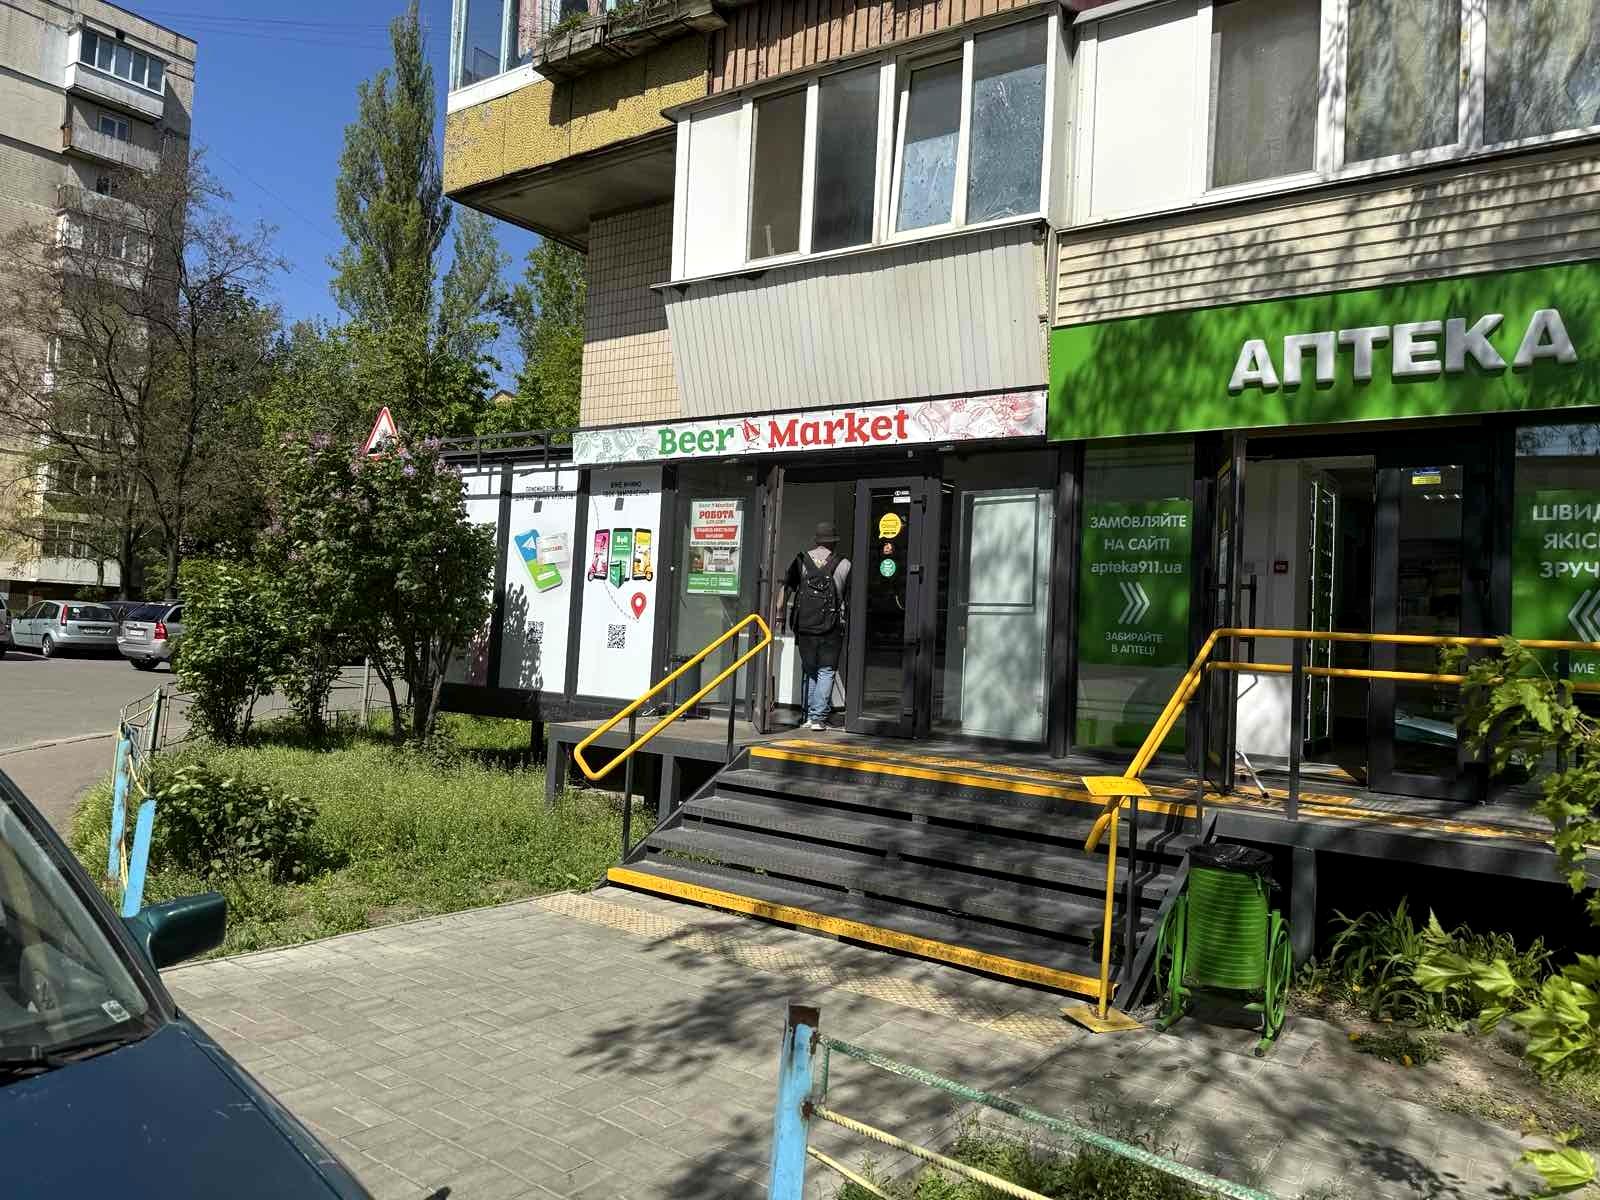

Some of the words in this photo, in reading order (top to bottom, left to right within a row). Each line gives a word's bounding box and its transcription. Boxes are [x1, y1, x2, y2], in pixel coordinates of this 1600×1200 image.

[1228, 308, 1579, 391] АПТЕКА
[658, 427, 734, 455] Beer
[768, 409, 909, 448] Market
[698, 510, 735, 520] РОБОТА
[1090, 512, 1187, 529] ЗАМОВЛЯЙТЕ
[1104, 538, 1125, 551] НА
[1543, 531, 1600, 551] ЯКІС
[1091, 560, 1182, 576] apteka911.ua
[1105, 631, 1166, 643] ЗАБИРАЙТЕ
[1111, 643, 1119, 653] В
